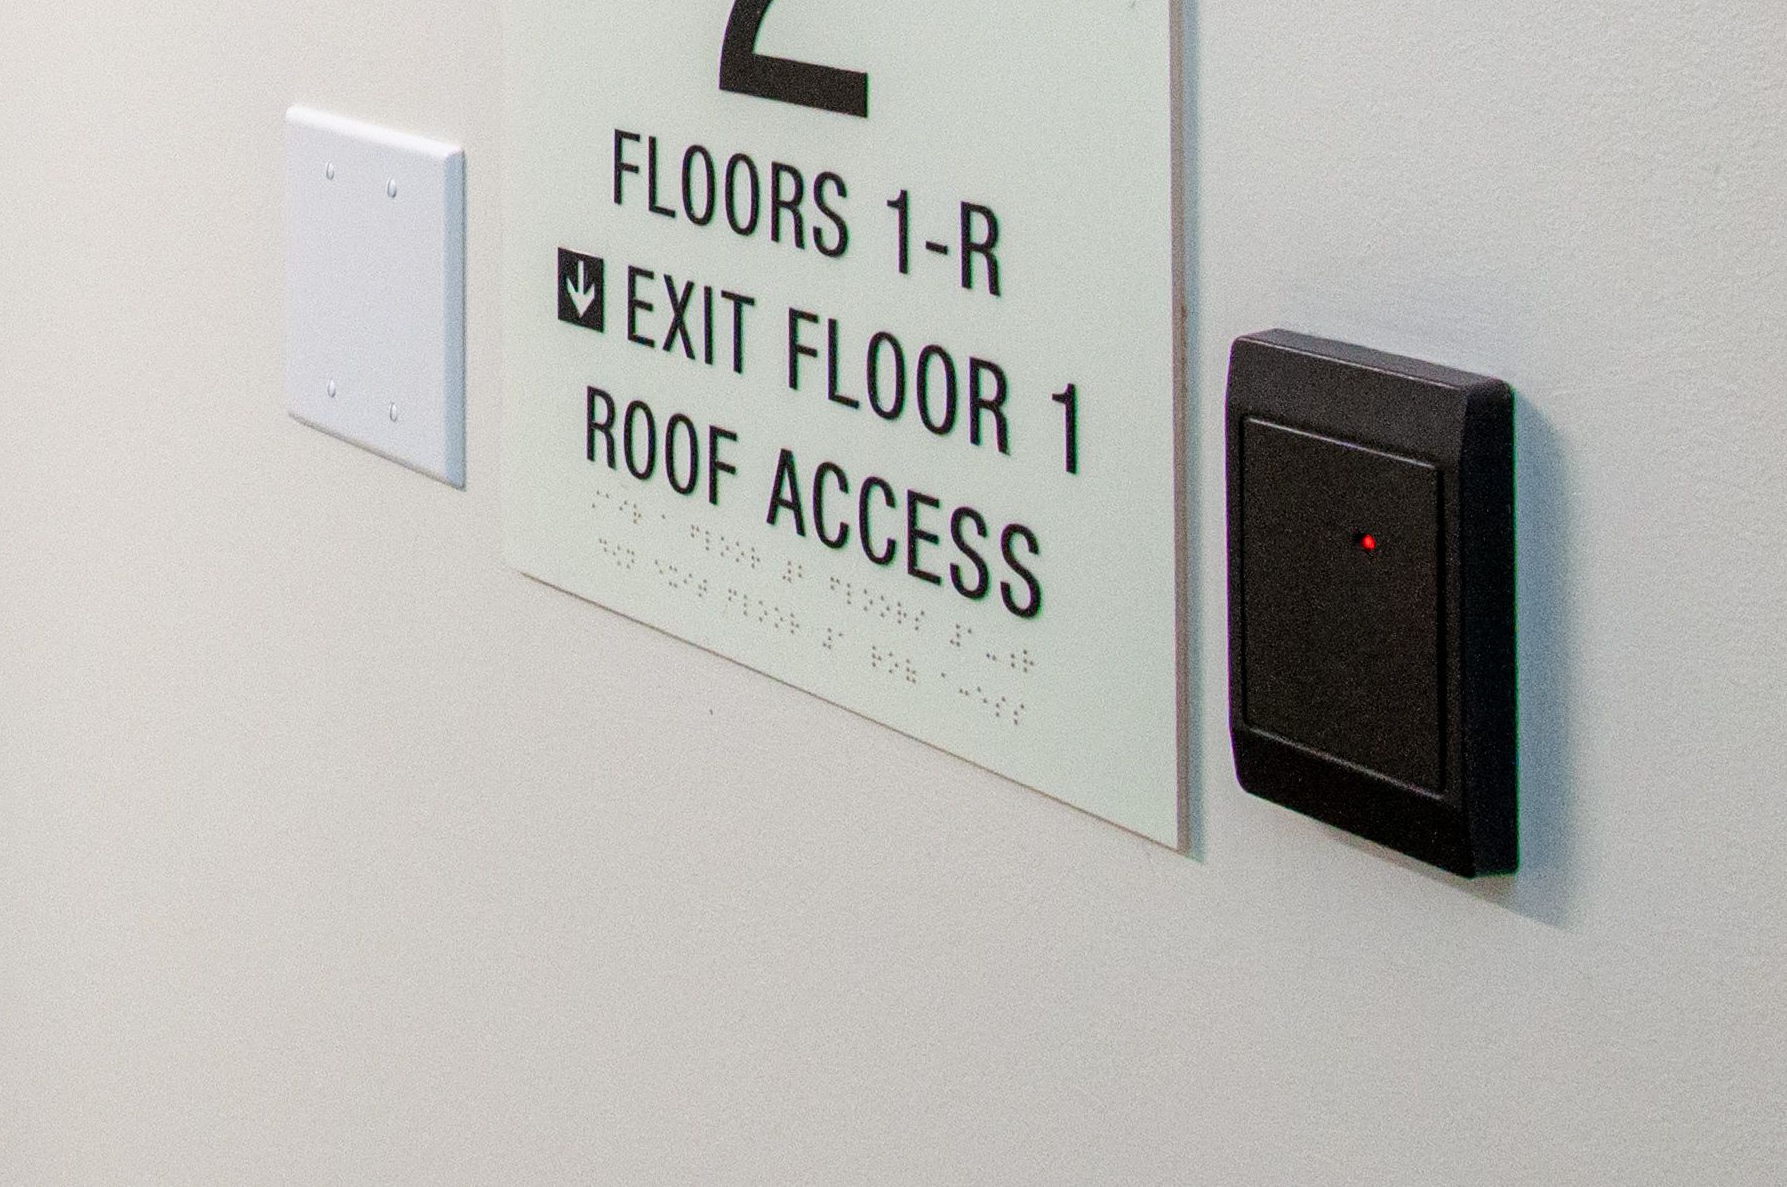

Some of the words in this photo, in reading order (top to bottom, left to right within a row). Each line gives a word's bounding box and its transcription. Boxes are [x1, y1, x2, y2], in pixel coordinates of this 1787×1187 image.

[613, 128, 850, 259] FLOORS
[886, 189, 1002, 298] 1-R
[627, 264, 756, 375] EXIT
[788, 307, 1010, 456] FLOOR
[1051, 382, 1078, 476] 1
[586, 385, 738, 506] ROOF
[766, 448, 1043, 620] ACCESS
